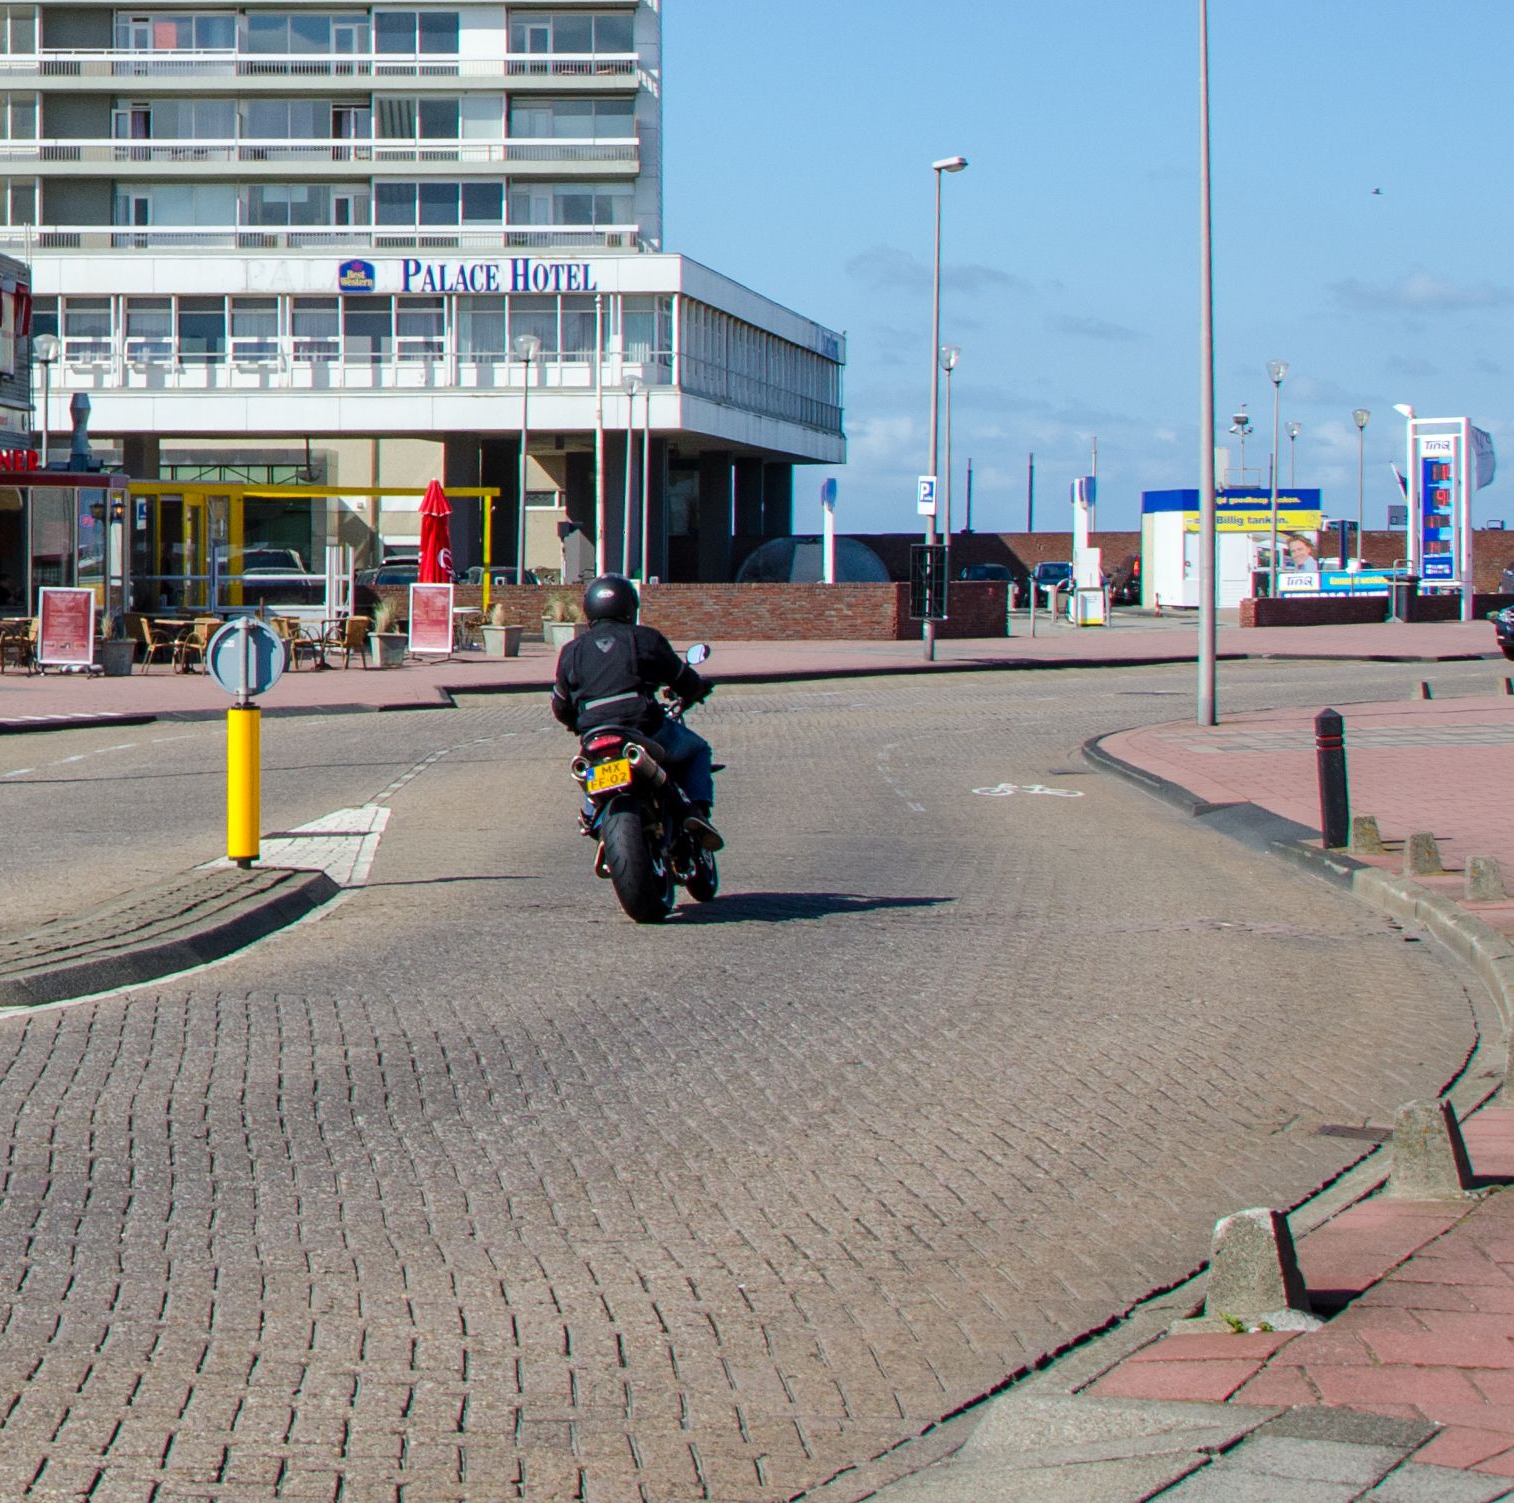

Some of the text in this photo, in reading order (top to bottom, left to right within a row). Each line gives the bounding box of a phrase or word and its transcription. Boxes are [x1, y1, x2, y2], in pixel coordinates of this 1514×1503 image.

[346, 269, 366, 279] Best
[400, 257, 598, 293] PALACE HOTEL
[339, 276, 373, 288] Western
[1216, 515, 1245, 527] Billig
[601, 762, 621, 776] MX
